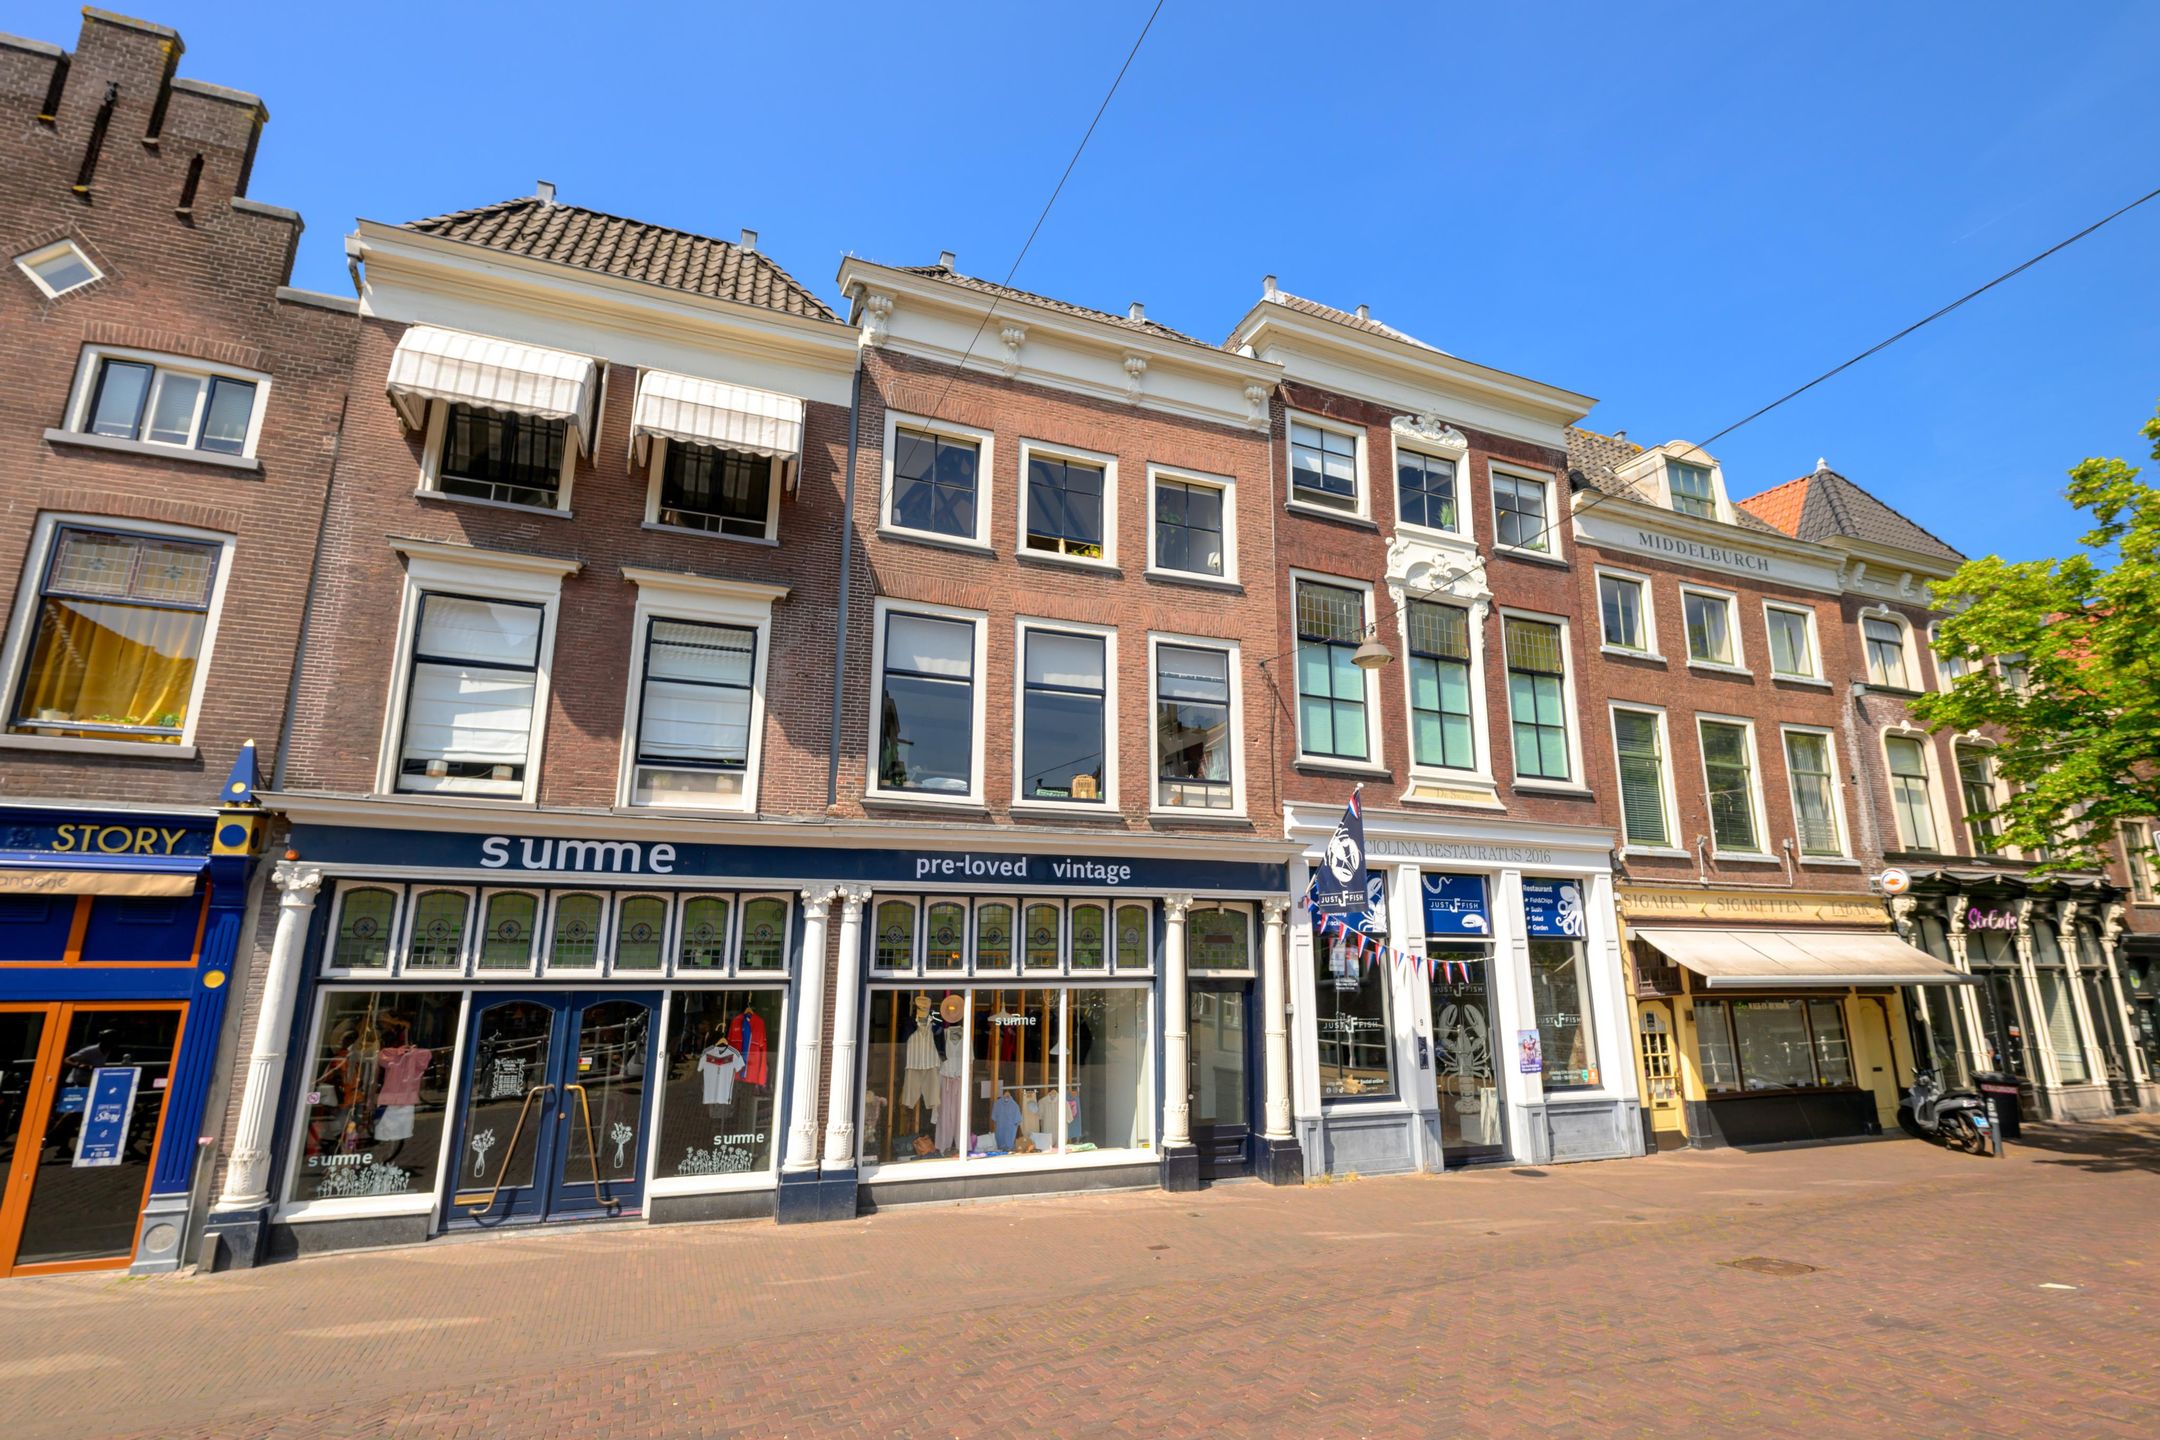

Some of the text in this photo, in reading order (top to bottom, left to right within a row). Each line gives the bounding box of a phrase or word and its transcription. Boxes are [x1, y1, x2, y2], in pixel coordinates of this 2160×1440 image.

[1638, 532, 1769, 571] MIDDELBURCH
[52, 824, 186, 855] STORY
[480, 836, 676, 874] summe
[1425, 843, 1523, 863] RESTAURATUS
[1525, 849, 1552, 864] 2016
[916, 854, 1132, 884] pre-loved vintage
[1522, 884, 1553, 893] Restaurant
[1321, 895, 1339, 904] JUST
[1349, 894, 1364, 902] FISH
[1624, 893, 1690, 910] SIGAREN
[1717, 896, 1804, 914] SIGARETTEN
[1968, 907, 2018, 930] StrEats
[1465, 985, 1484, 993] FISH
[994, 1015, 1037, 1026] summe
[1565, 1016, 1581, 1024] FISH
[713, 1133, 765, 1146] summe
[308, 1152, 374, 1168] summe
